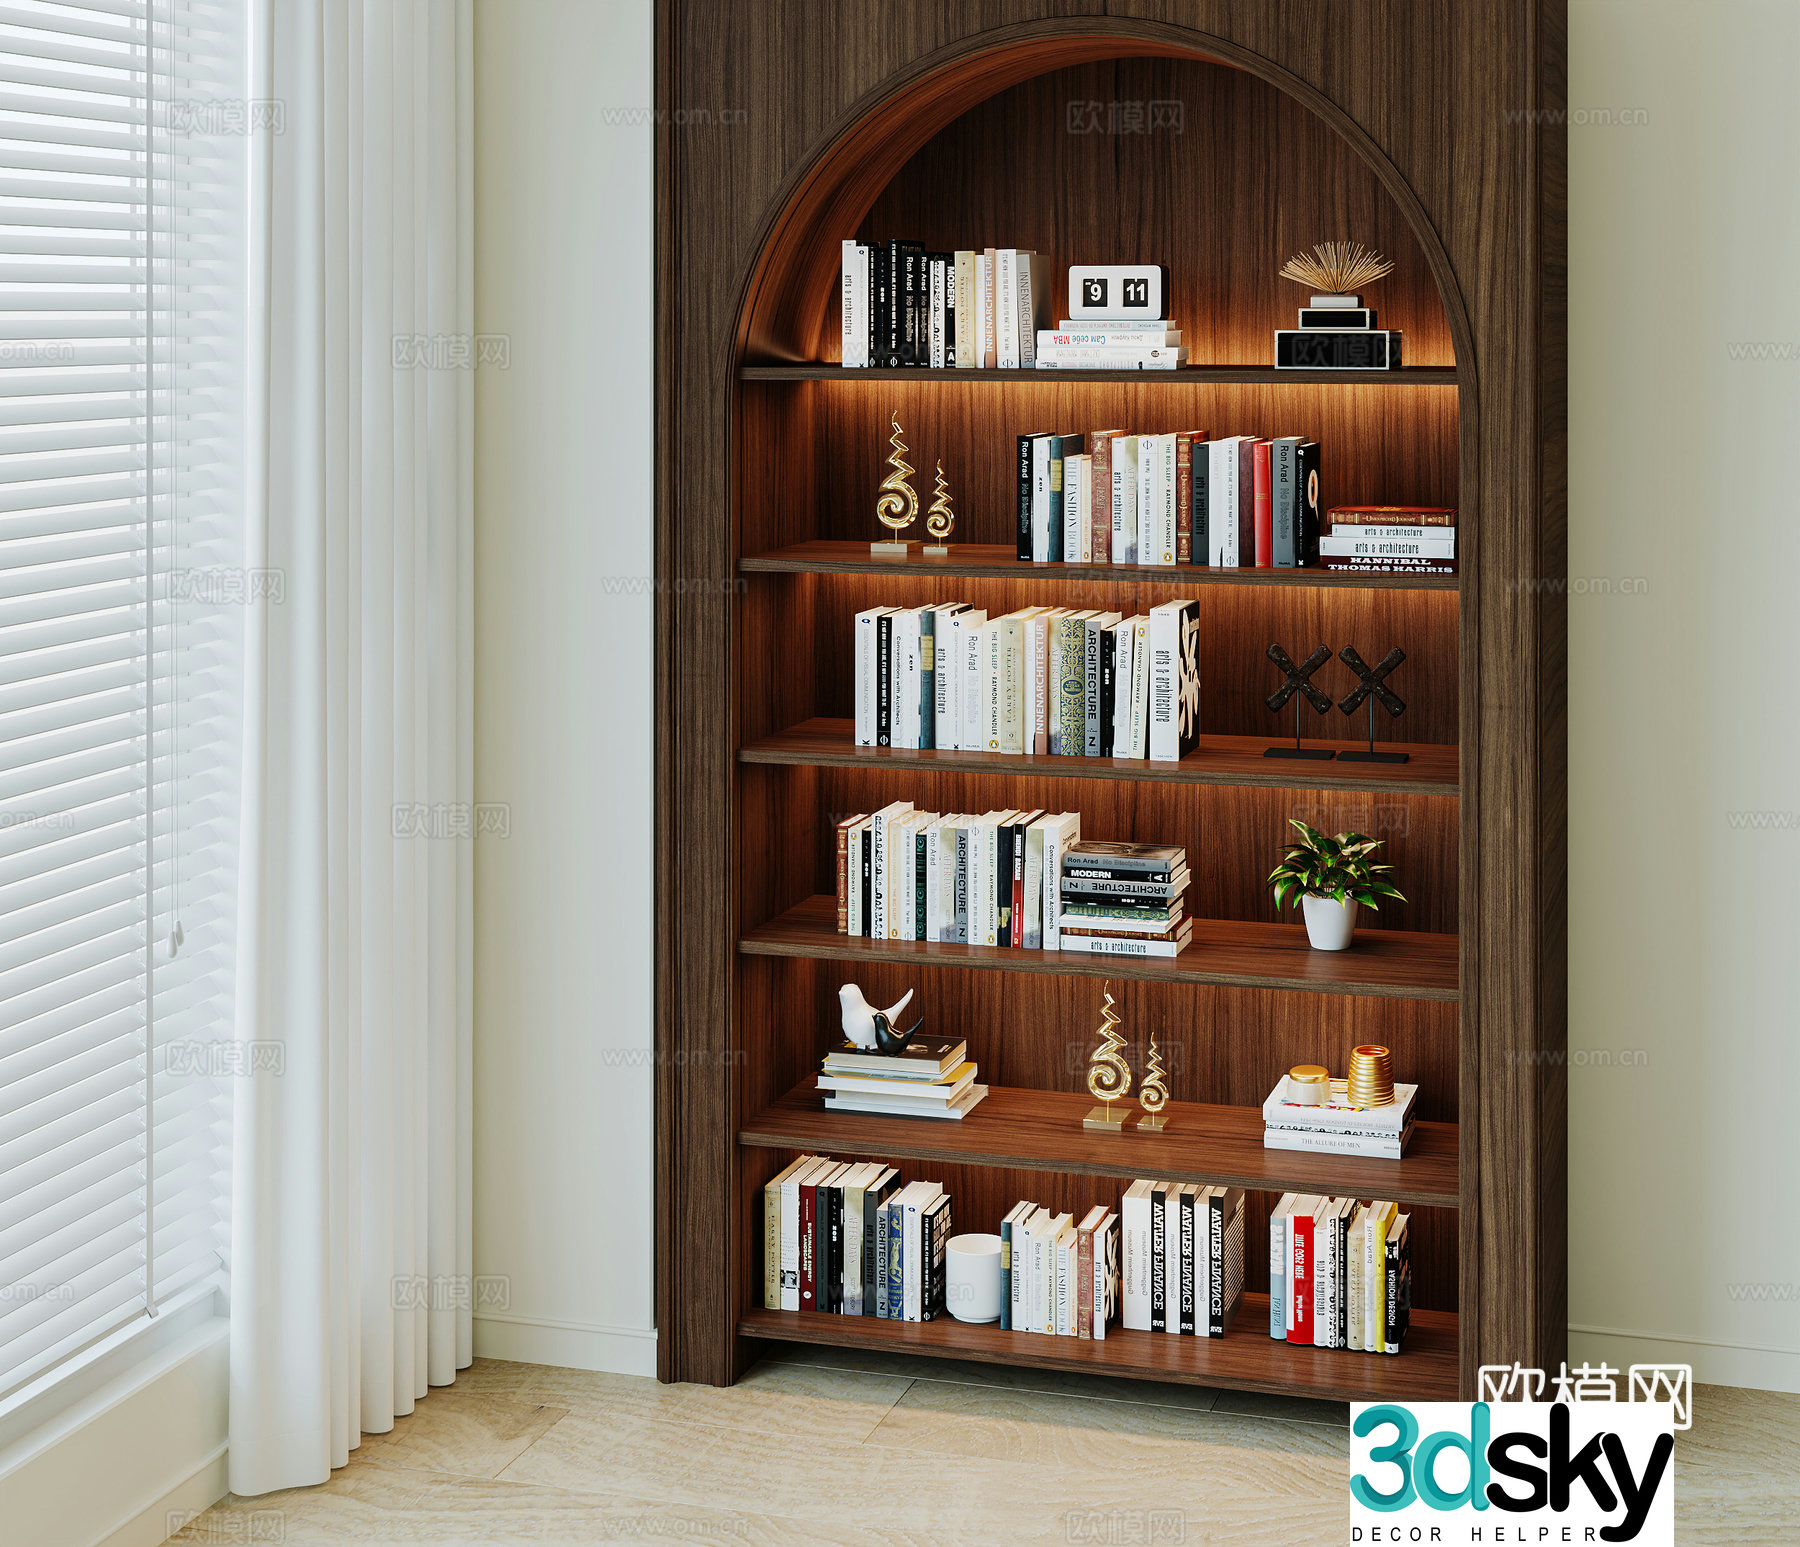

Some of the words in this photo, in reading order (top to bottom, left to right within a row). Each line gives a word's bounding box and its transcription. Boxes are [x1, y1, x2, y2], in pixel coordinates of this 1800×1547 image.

[1090, 284, 1102, 301] 9
[1127, 284, 1144, 301] 11
[1020, 271, 1032, 364] INNENARCHITEKTUR
[1053, 336, 1070, 344] MBA
[1072, 336, 1088, 344] себе
[1091, 336, 1105, 344] Сам
[1067, 460, 1076, 481] THE
[1114, 472, 1122, 483] arts
[1022, 484, 1028, 494] No
[1280, 488, 1288, 499] No
[1067, 483, 1077, 527] FASHION
[1114, 494, 1122, 531] architecture
[1387, 528, 1422, 536] architecture
[1067, 530, 1076, 559] BOOK
[1355, 542, 1368, 553] arts
[1379, 542, 1418, 554] architecture
[1392, 565, 1453, 573] HARRIS
[969, 636, 977, 650] Ron
[1120, 631, 1128, 646] Ron
[938, 648, 946, 661] arts
[969, 653, 977, 671] Arad
[1120, 650, 1128, 669] Arad
[1156, 650, 1172, 665] arts
[1036, 625, 1044, 734] INNENARCHITEKTUR
[1088, 630, 1096, 719] ARCHITECTURE
[938, 673, 947, 713] architecture
[1156, 677, 1173, 722] architecture
[1071, 870, 1111, 878] MODERN
[1092, 883, 1167, 894] ARCHITECTURE
[1091, 941, 1102, 950] arts
[1112, 942, 1146, 953] architecture
[1058, 1248, 1066, 1266] THE
[1058, 1268, 1066, 1306] FASHION
[1058, 1308, 1066, 1333] BOOK
